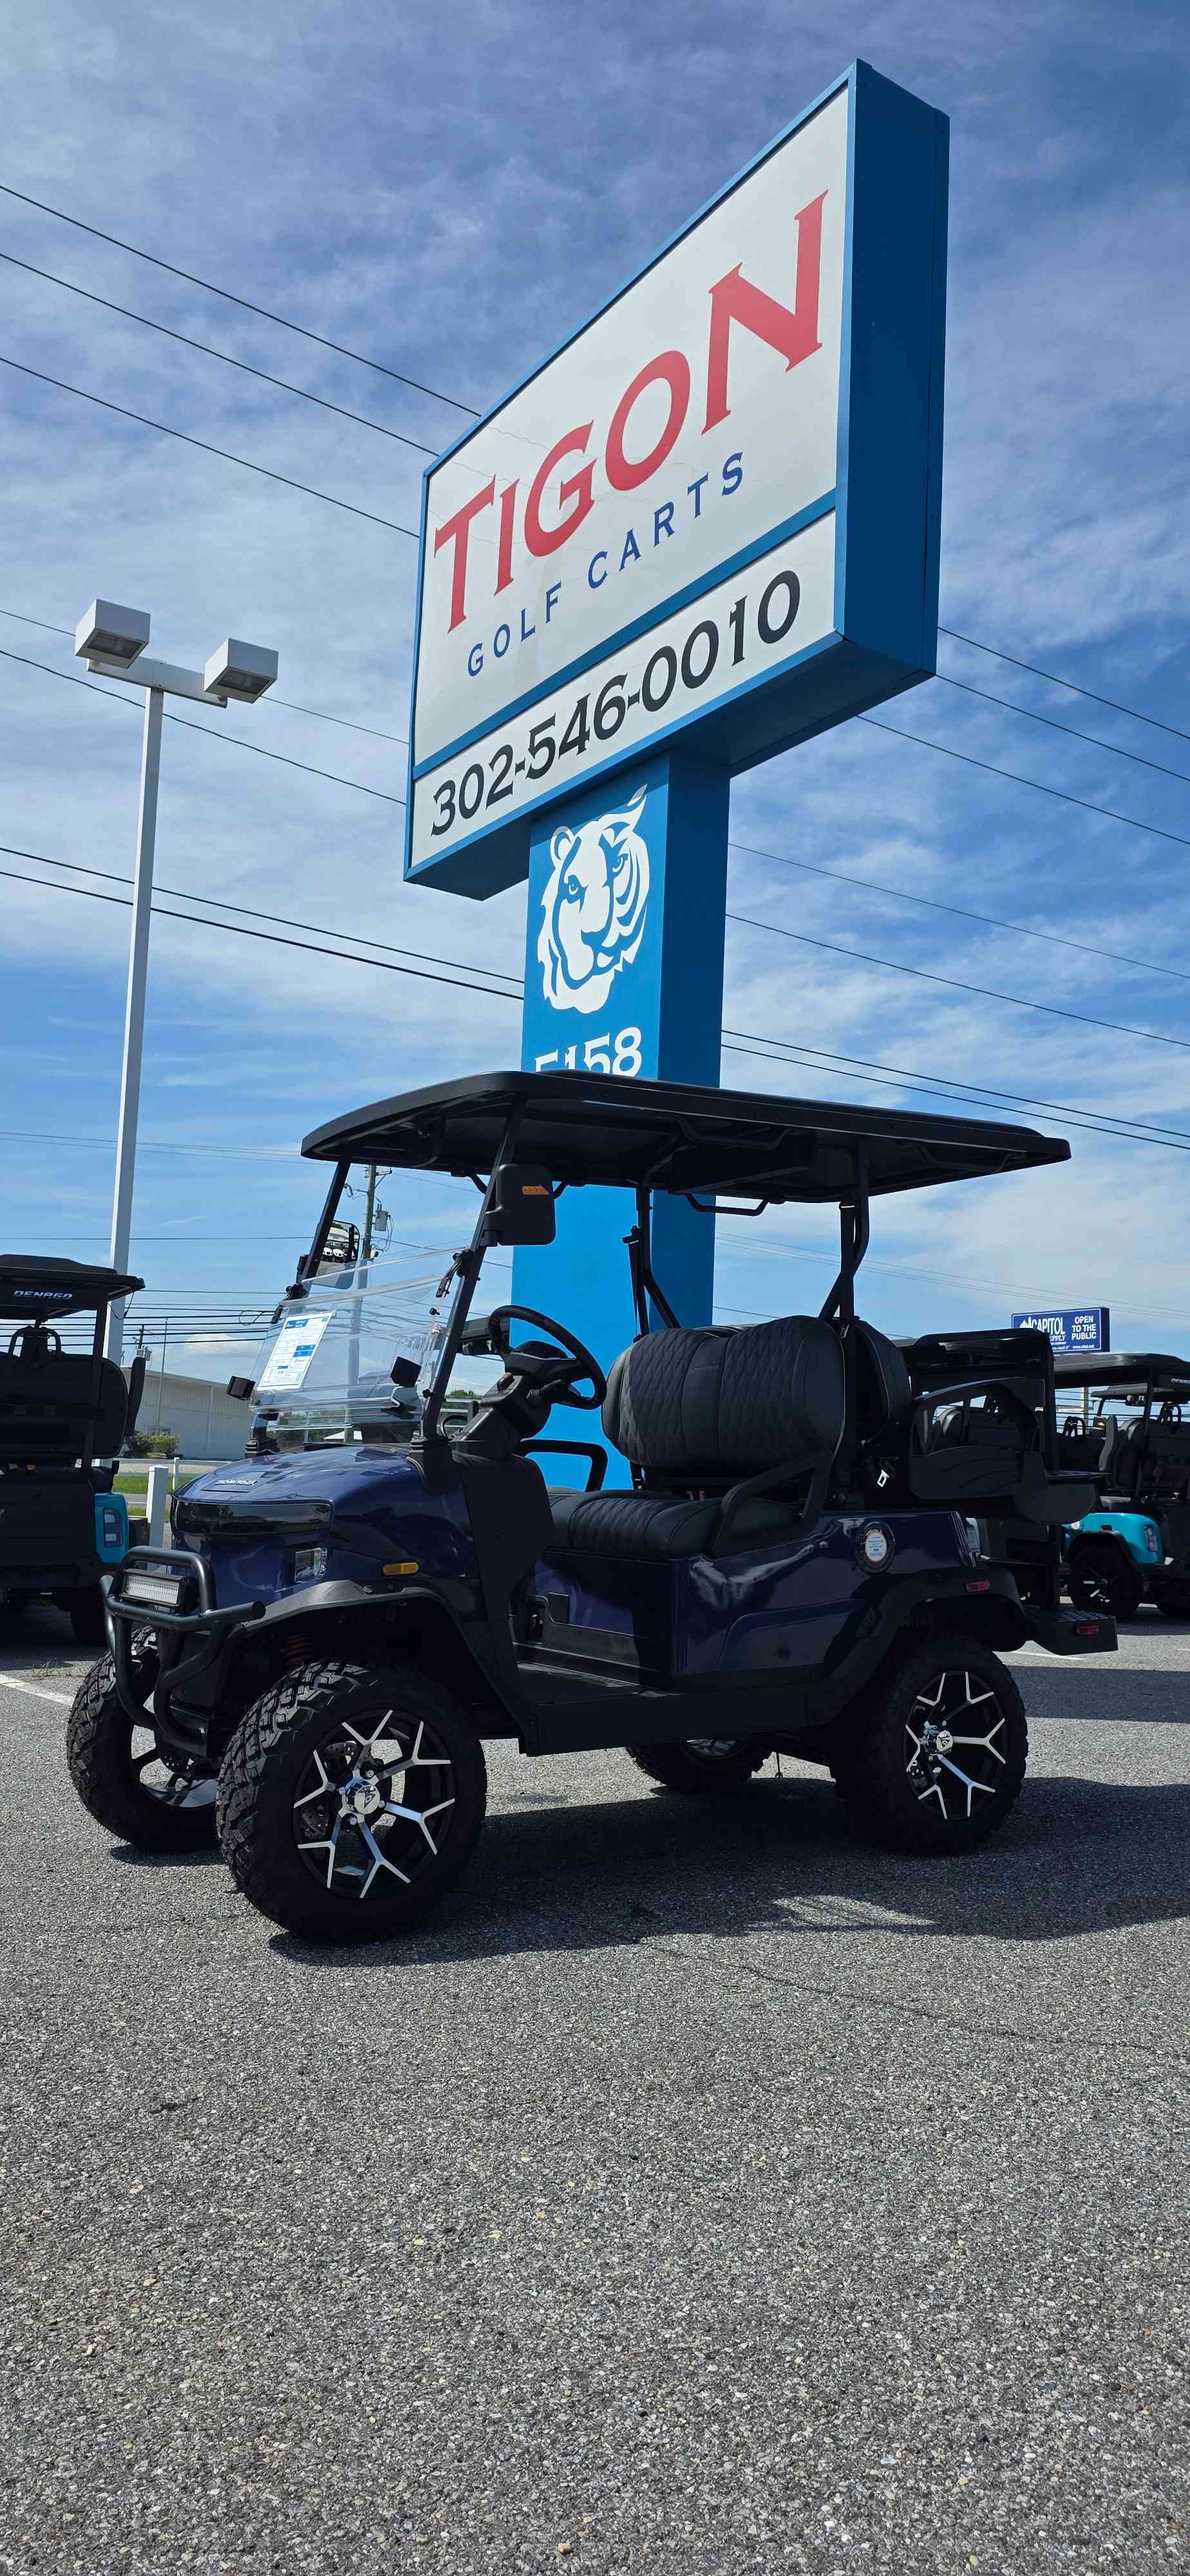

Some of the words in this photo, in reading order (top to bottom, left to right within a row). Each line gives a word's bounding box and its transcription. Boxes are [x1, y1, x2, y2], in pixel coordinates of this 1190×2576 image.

[434, 189, 829, 633] TIGON
[467, 582, 562, 677] GOLF
[587, 452, 744, 589] CARTS
[430, 570, 801, 837] 302-546-0010
[1072, 1324, 1081, 1332] TO
[1082, 1323, 1097, 1332] THE
[1072, 1332, 1097, 1340] PUBLIC
[1075, 1315, 1093, 1324] OPEN
